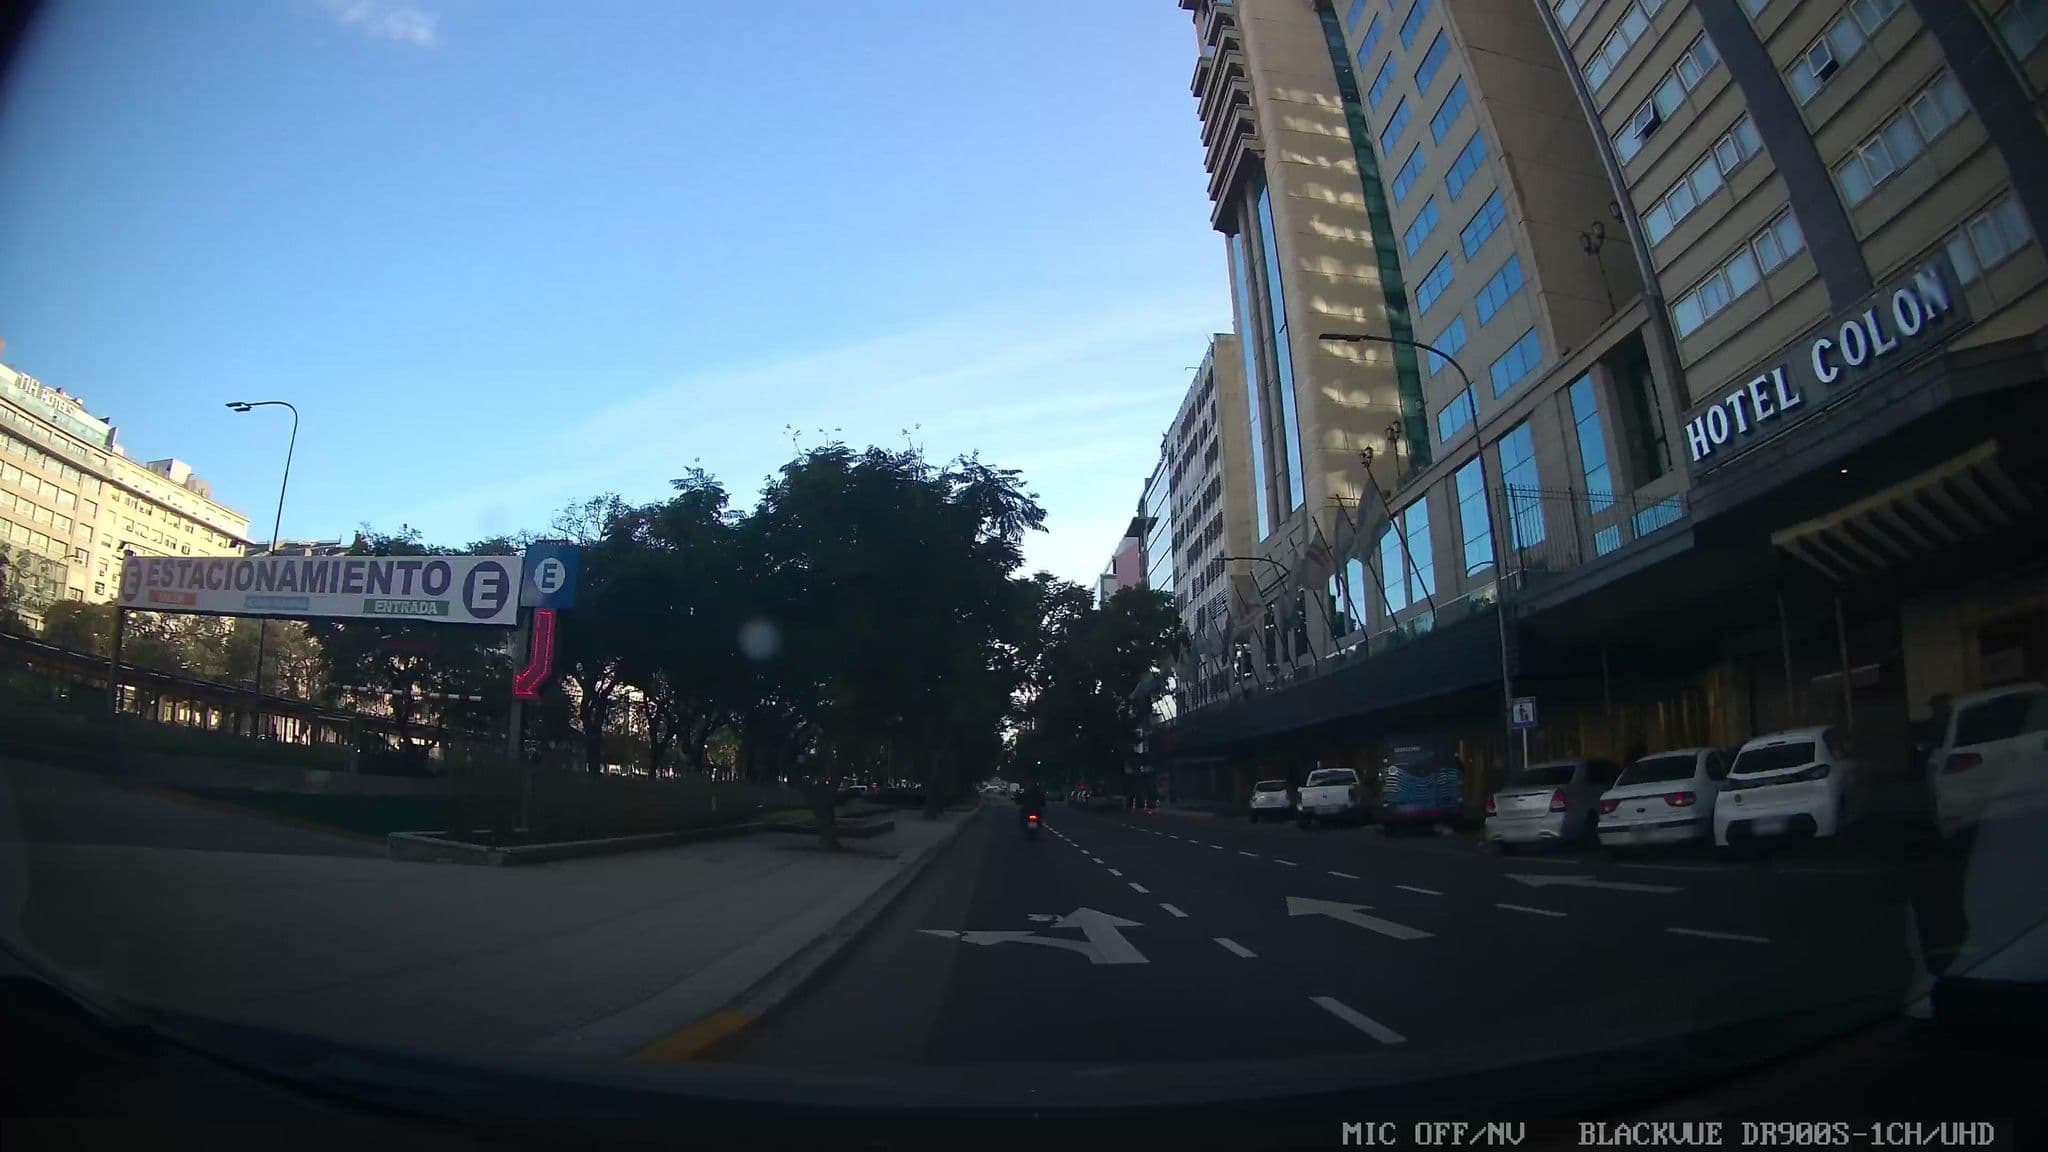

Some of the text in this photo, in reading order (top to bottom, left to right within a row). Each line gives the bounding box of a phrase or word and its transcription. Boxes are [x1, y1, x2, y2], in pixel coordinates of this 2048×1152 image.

[1684, 262, 1950, 462] HOTEL COLON
[146, 559, 450, 596] ESTACIONAMIENTO
[471, 571, 500, 608] E
[541, 563, 558, 589] E
[373, 600, 439, 615] ENTRADA
